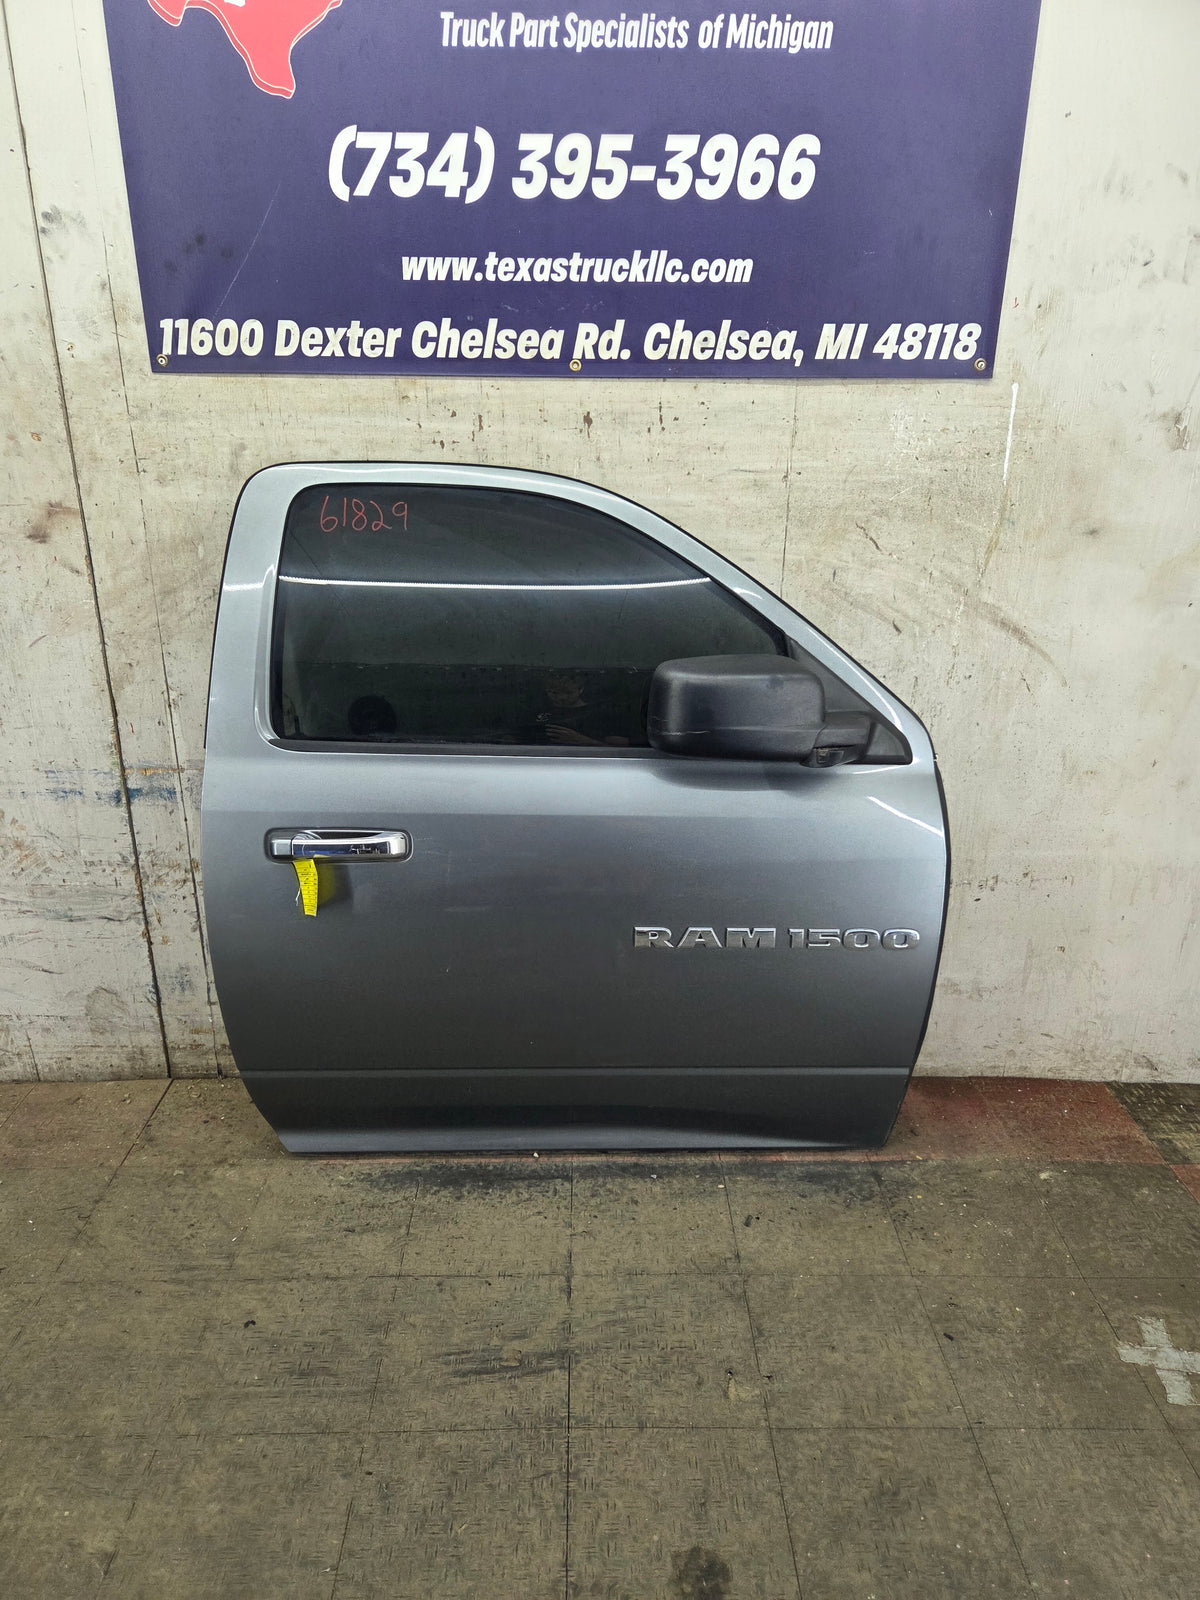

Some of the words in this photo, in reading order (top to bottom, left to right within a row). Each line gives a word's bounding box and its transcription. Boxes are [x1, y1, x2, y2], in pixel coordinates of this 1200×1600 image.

[439, 11, 506, 48] Truck
[508, 11, 561, 48] Part
[562, 11, 690, 53] Specialists
[697, 13, 725, 49] of
[725, 13, 834, 55] Michigan
[328, 124, 495, 205] (734)
[511, 132, 821, 201] 395-3966
[401, 249, 754, 283] www.texastruckllc.com
[158, 318, 264, 357] 11600
[274, 319, 403, 358] Dexter
[411, 317, 565, 360] Chelsea
[573, 319, 631, 361] Rd.
[643, 319, 804, 367] Chelsea,
[814, 323, 869, 360] MI
[872, 322, 982, 361] 48118
[320, 495, 410, 534] 61829
[633, 926, 777, 949] RAM
[787, 927, 921, 950] 1500
